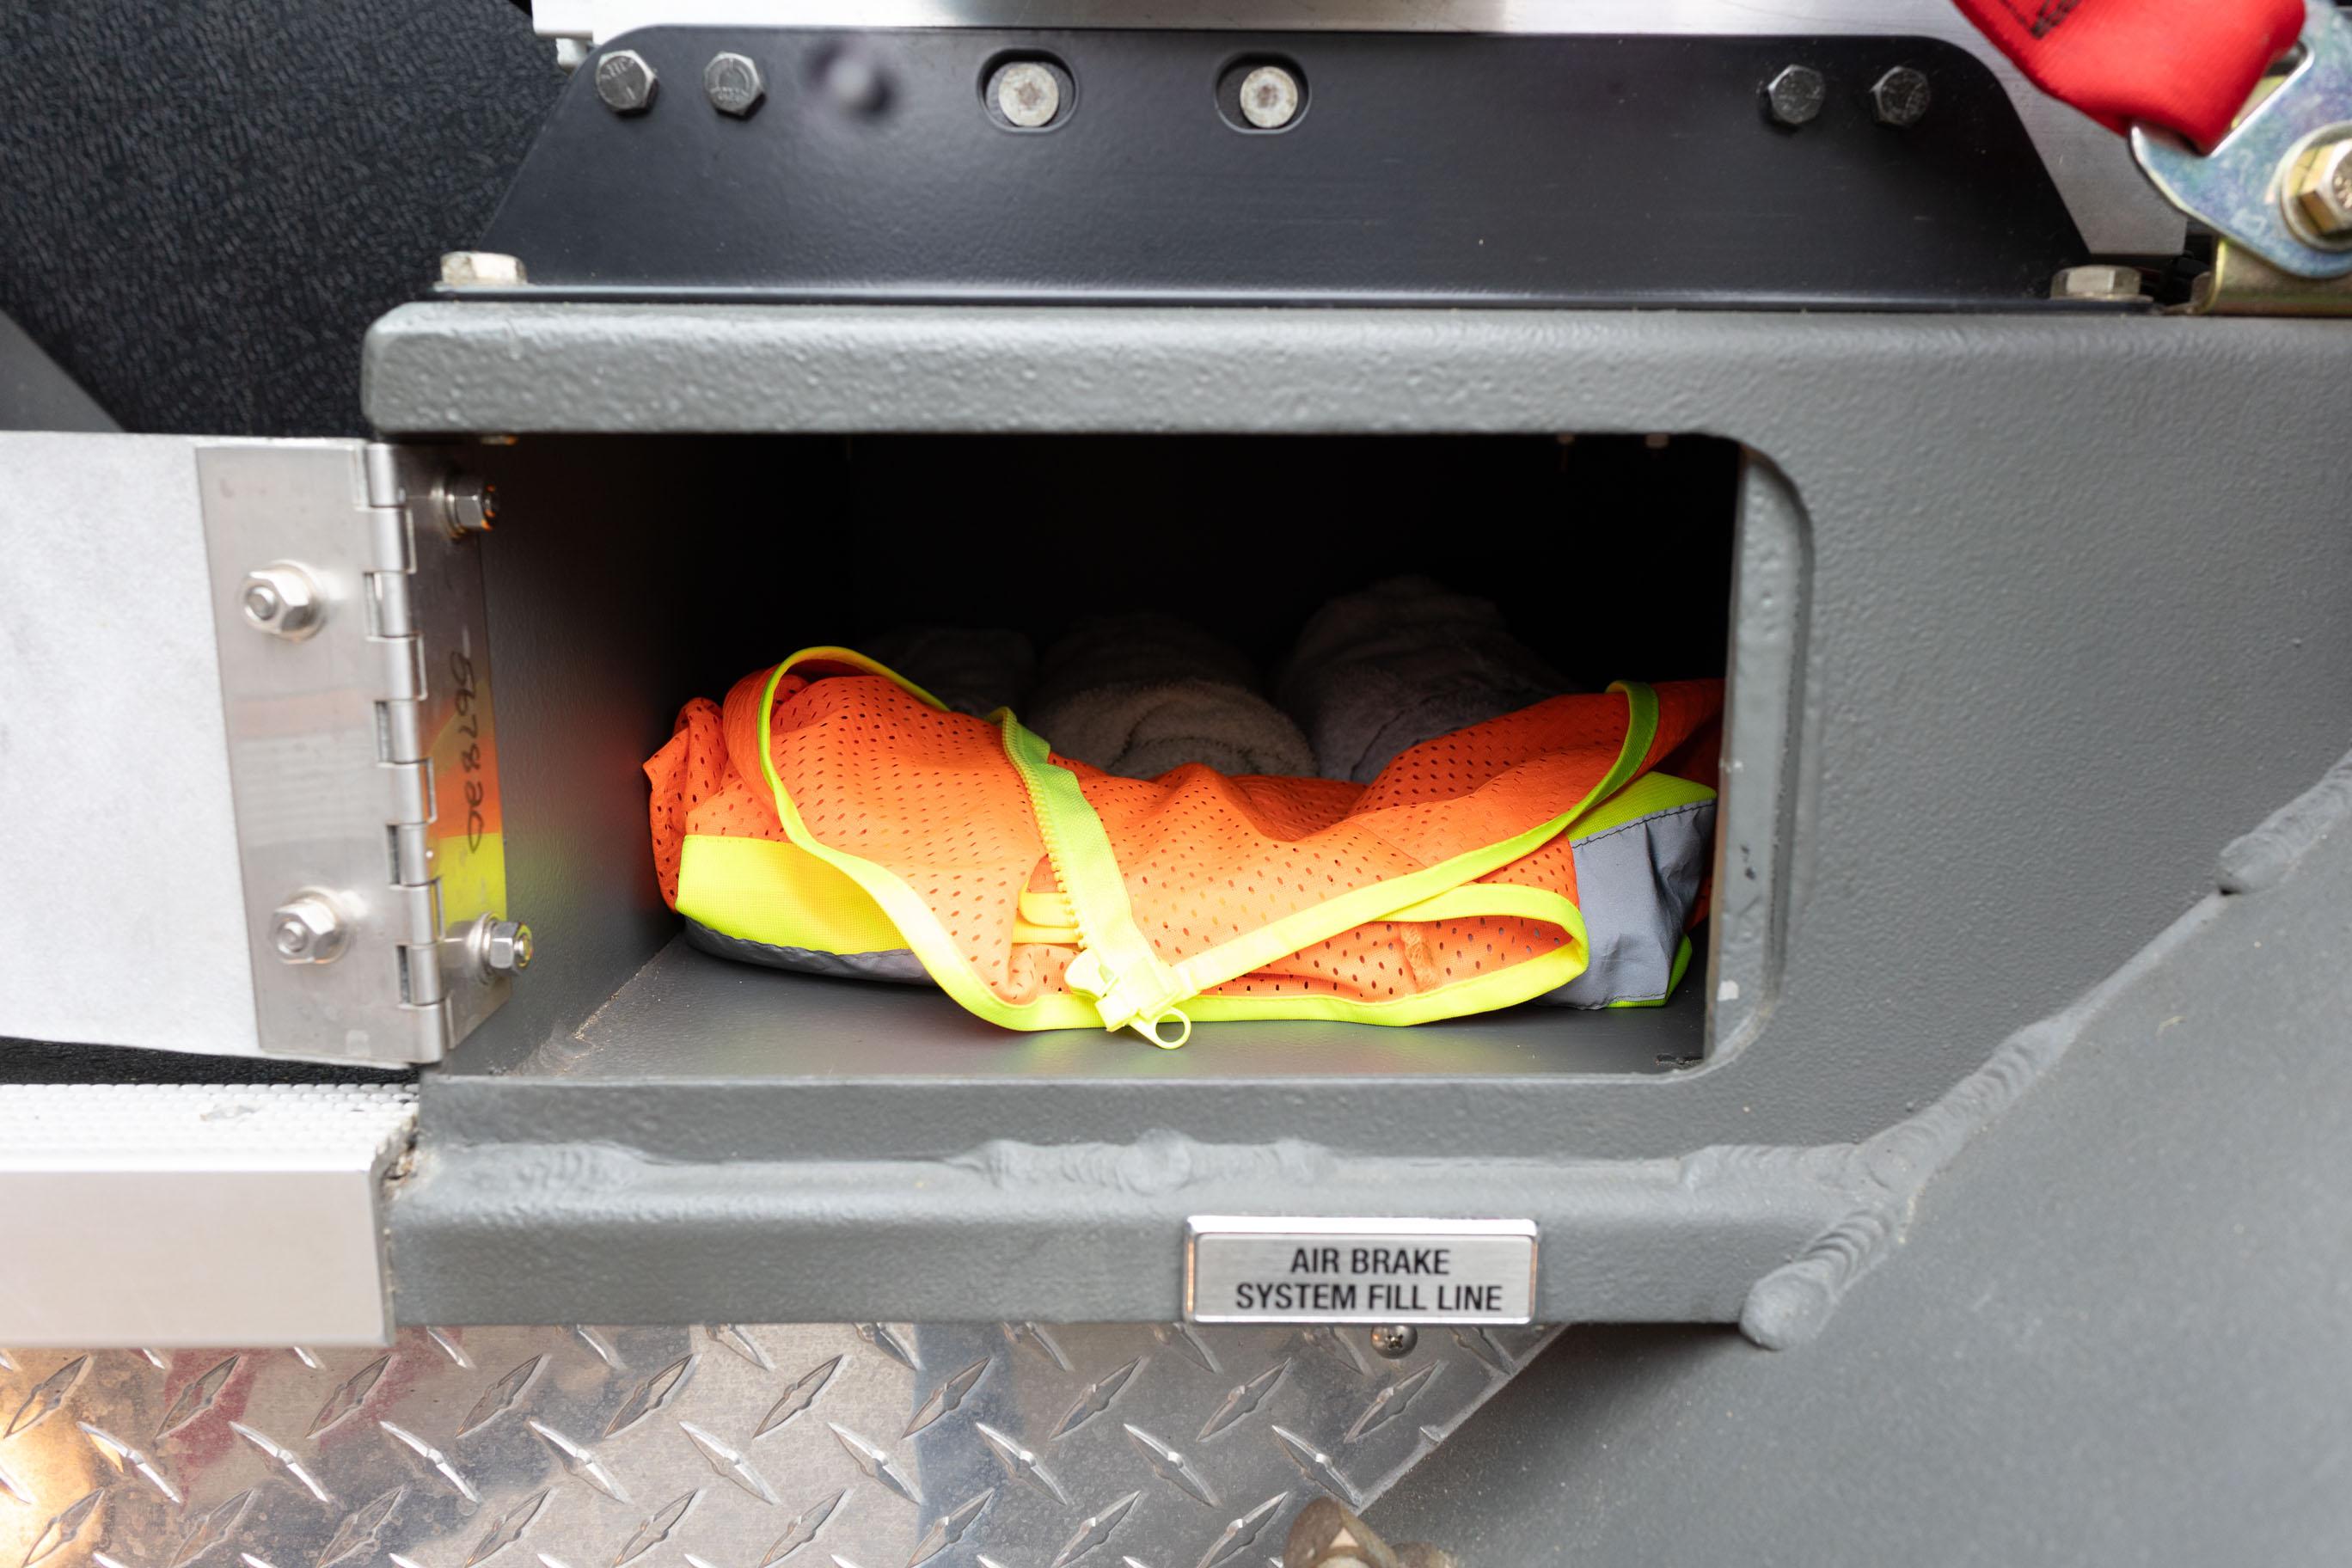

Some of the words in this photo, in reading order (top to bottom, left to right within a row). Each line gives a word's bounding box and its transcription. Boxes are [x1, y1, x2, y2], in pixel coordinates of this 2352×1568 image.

[1289, 1247, 1340, 1274] AIR
[1351, 1248, 1450, 1275] BRAKE
[1235, 1282, 1357, 1310] SYSTEM
[1368, 1283, 1427, 1311] FILL
[1437, 1285, 1502, 1312] LINE
